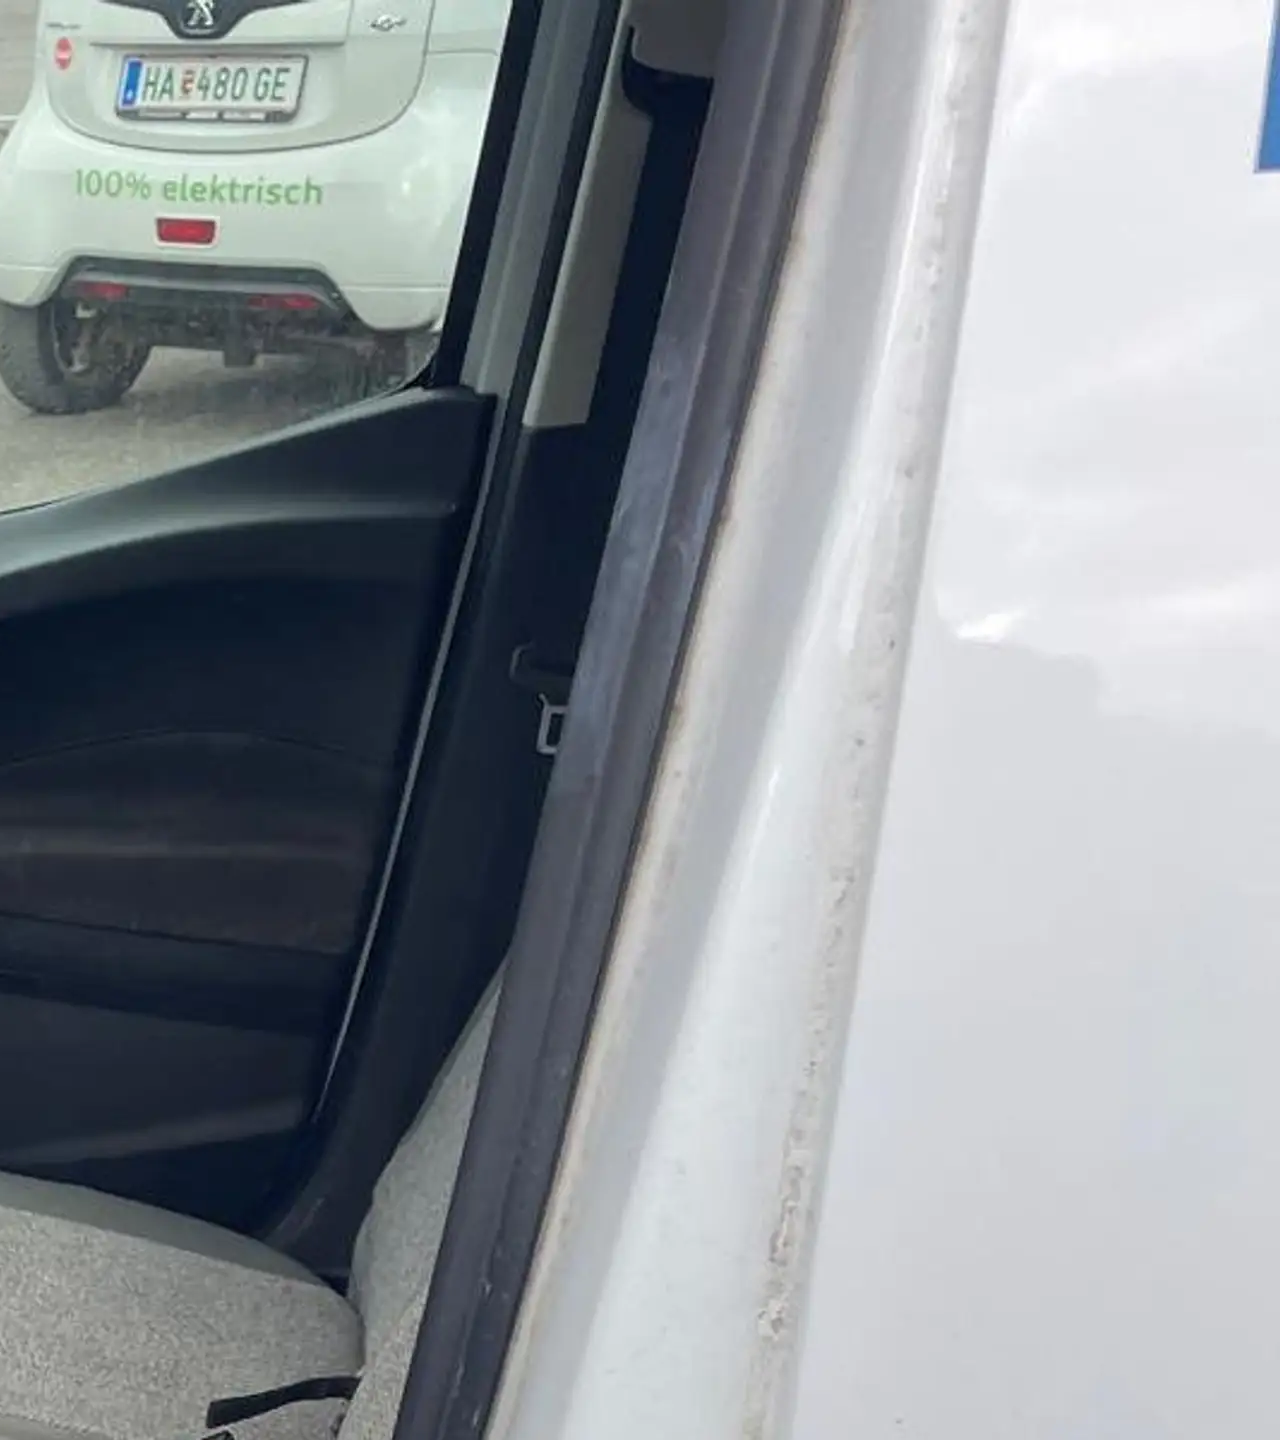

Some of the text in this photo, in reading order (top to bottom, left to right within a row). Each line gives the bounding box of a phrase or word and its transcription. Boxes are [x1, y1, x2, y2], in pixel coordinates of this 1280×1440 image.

[141, 66, 291, 101] HA 480 GE
[75, 168, 324, 205] 100% elektrisch
